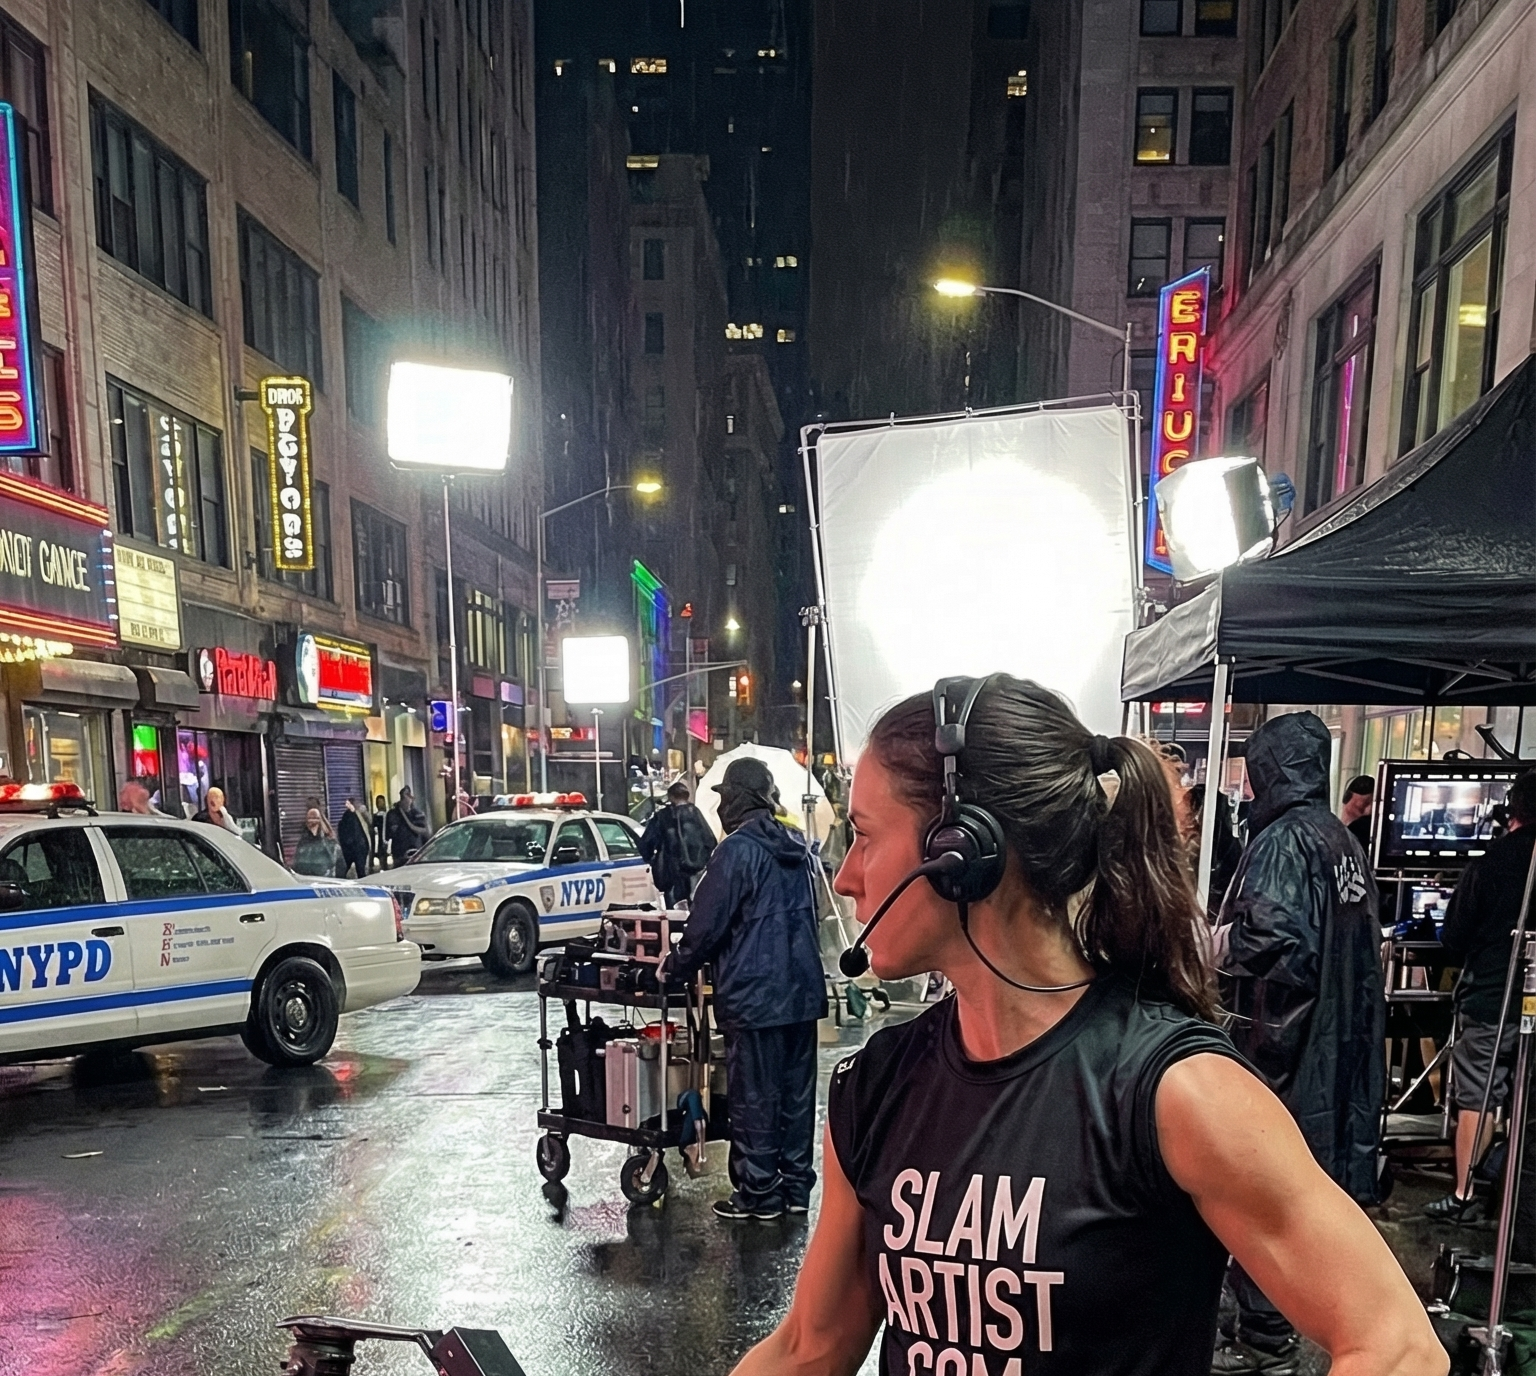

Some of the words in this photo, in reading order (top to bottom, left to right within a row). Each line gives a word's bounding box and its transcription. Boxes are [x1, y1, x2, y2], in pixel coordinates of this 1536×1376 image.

[560, 878, 606, 907] NYPD
[0, 939, 112, 992] NYPD
[883, 1168, 1046, 1264] SLAM
[878, 1252, 1065, 1352] ARTIST
